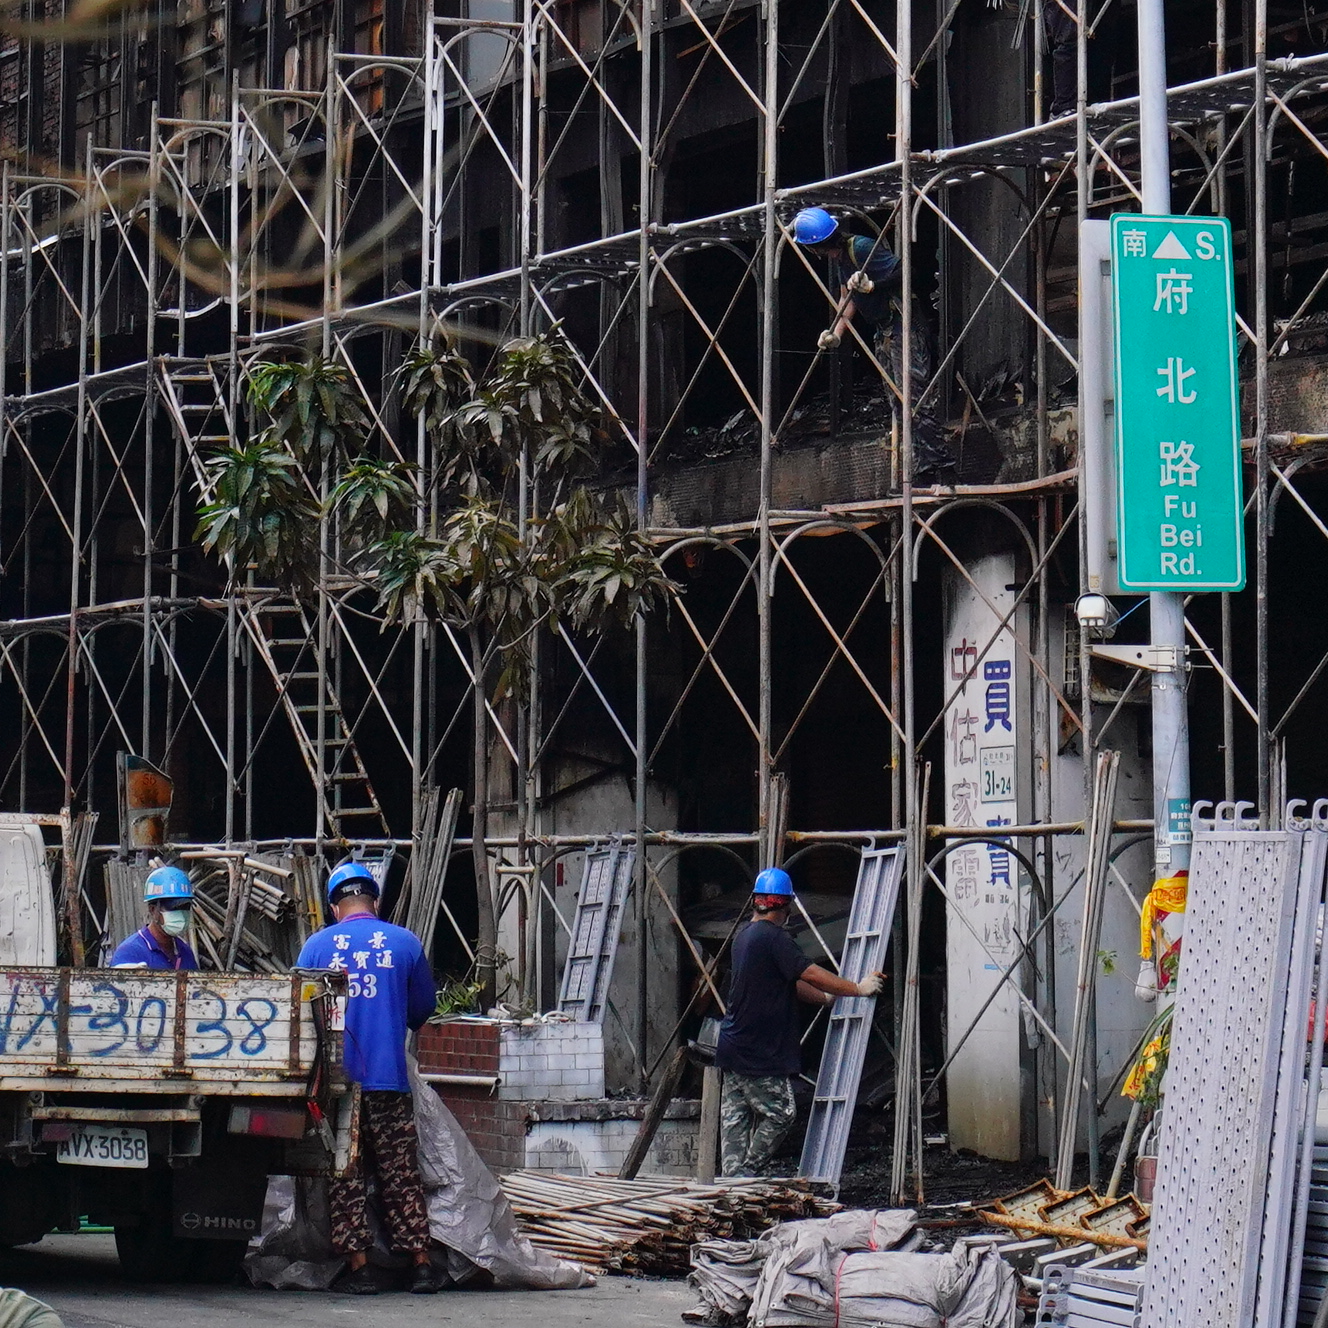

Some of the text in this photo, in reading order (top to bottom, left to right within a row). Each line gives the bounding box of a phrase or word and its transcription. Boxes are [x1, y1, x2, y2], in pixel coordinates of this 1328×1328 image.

[1122, 229, 1147, 258] 南
[1195, 231, 1221, 261] S.
[1153, 268, 1201, 487] 府北路
[1164, 496, 1196, 519] Fu
[1160, 524, 1202, 547] Bei
[1160, 553, 1202, 575] Rd.
[347, 973, 378, 999] 53
[204, 1216, 256, 1230] HINO
